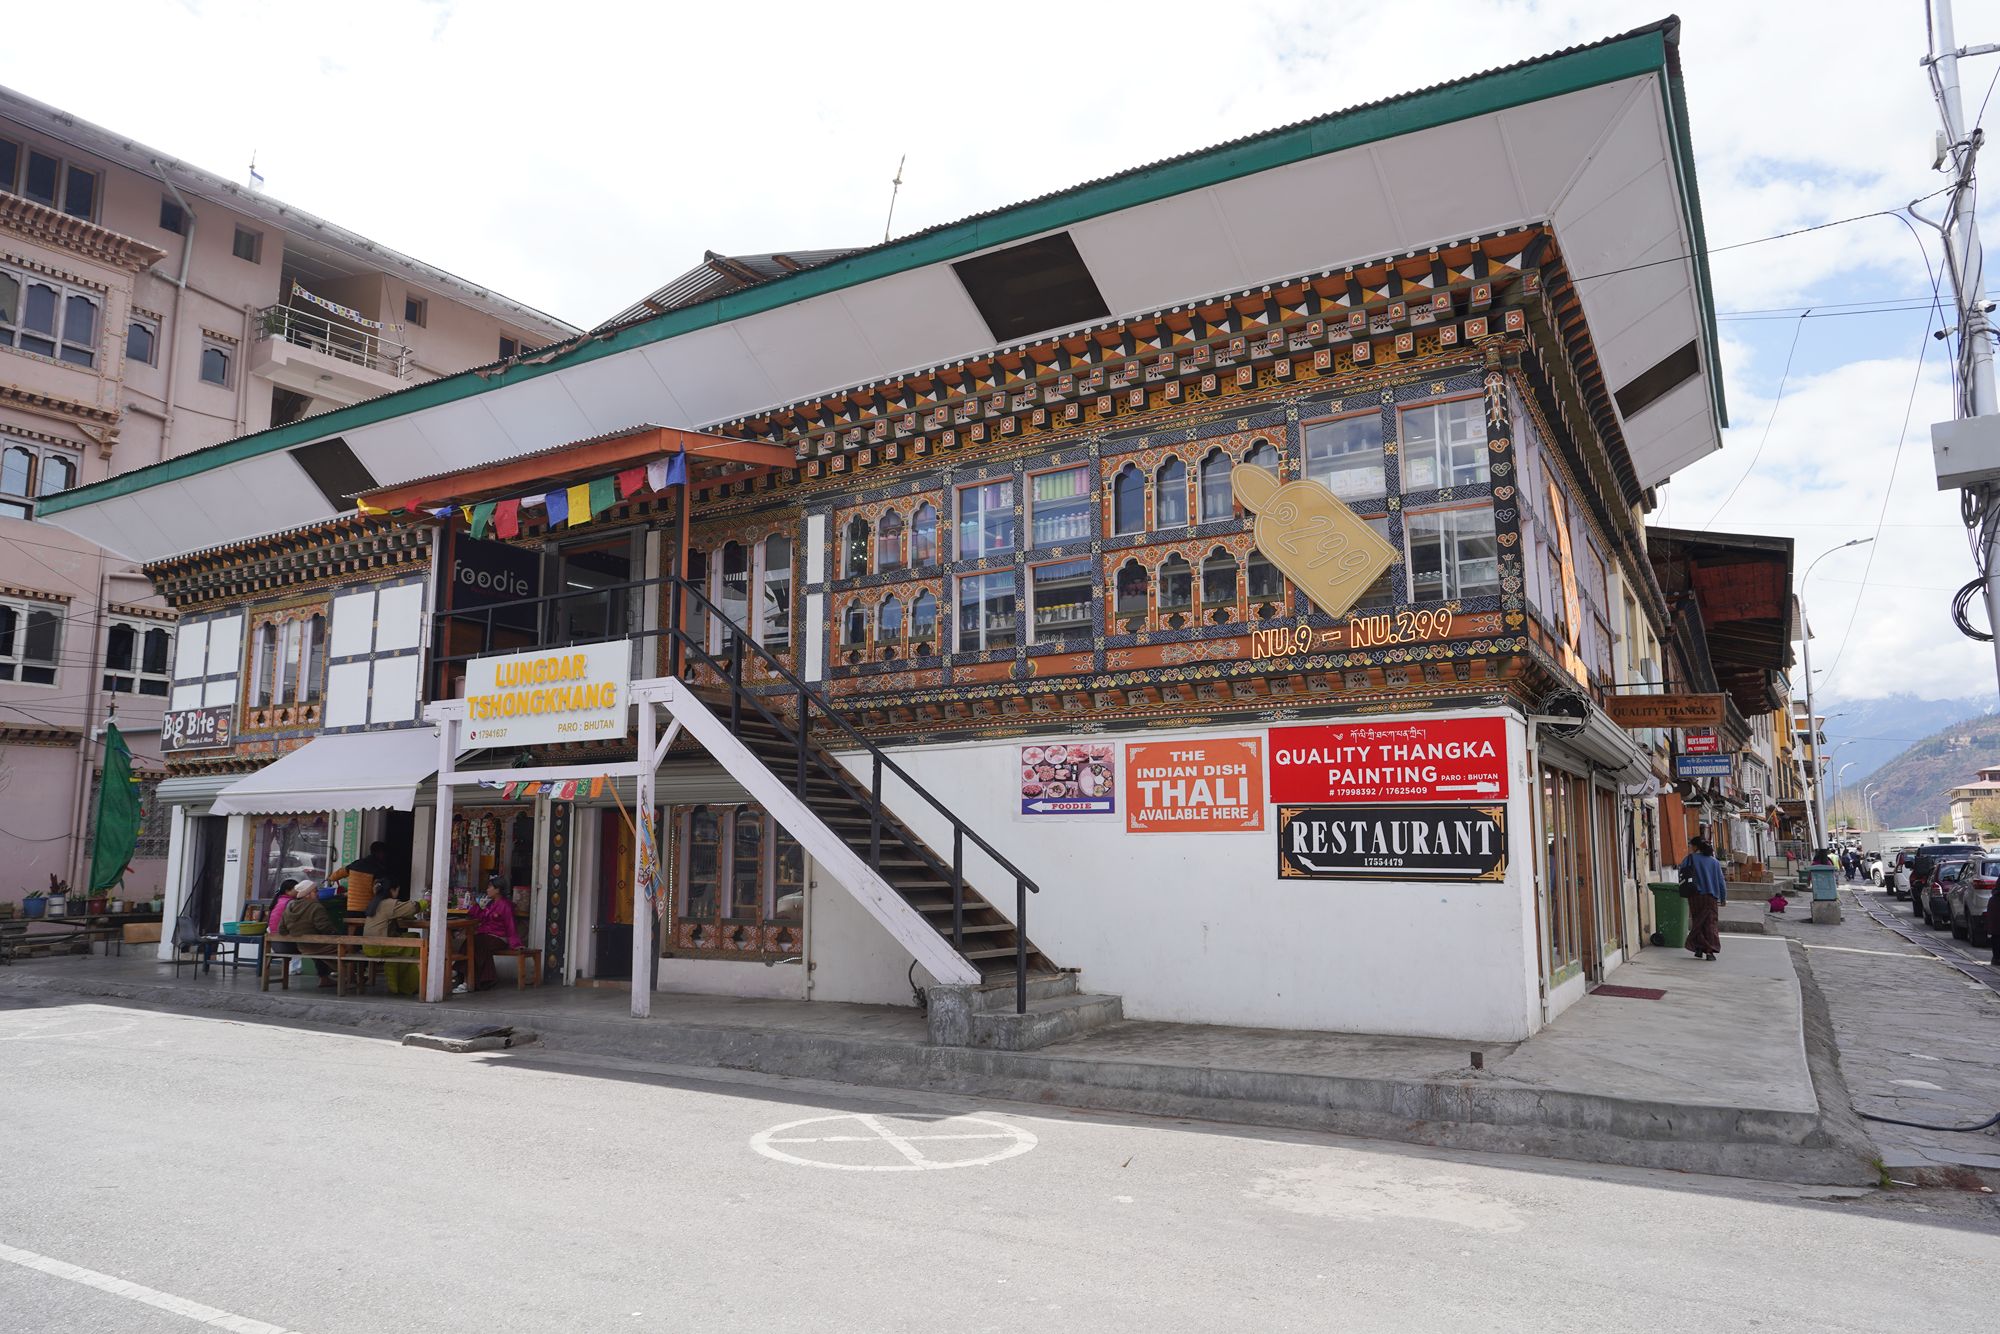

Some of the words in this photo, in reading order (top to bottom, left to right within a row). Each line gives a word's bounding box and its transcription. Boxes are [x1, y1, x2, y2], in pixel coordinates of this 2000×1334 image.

[1277, 515, 1371, 586] 299
[453, 559, 529, 596] foodie
[1252, 624, 1313, 660] NU.9
[1350, 607, 1453, 649] NU.299
[495, 653, 588, 689] LUNGDAR
[467, 681, 617, 721] TSHONGKHANG
[1613, 707, 1660, 717] QUALITY
[1663, 706, 1717, 716] THANGKA
[162, 711, 186, 749] Big
[186, 709, 215, 736] Bite
[558, 722, 578, 733] PARO
[584, 719, 615, 731] BHUTAN
[1170, 750, 1206, 762] THE
[1275, 745, 1371, 766] QUALITY
[1379, 740, 1496, 762] THANGKA
[1137, 765, 1198, 779] INDIAN
[1203, 764, 1247, 776] DISH
[1328, 765, 1437, 785] PAINTING
[1441, 774, 1461, 782] PARO
[1467, 773, 1499, 781] BHUTAN
[1137, 777, 1249, 808] THALI
[1337, 787, 1377, 796] 17998392
[1385, 786, 1428, 795] 17625409
[1051, 802, 1092, 810] FOODIE
[1753, 794, 1762, 813] ATM
[1138, 808, 1209, 821] AVAILABLE
[1213, 807, 1249, 819] HERE
[1291, 820, 1495, 856] RESTAURANT
[1364, 857, 1403, 867] 17554479
